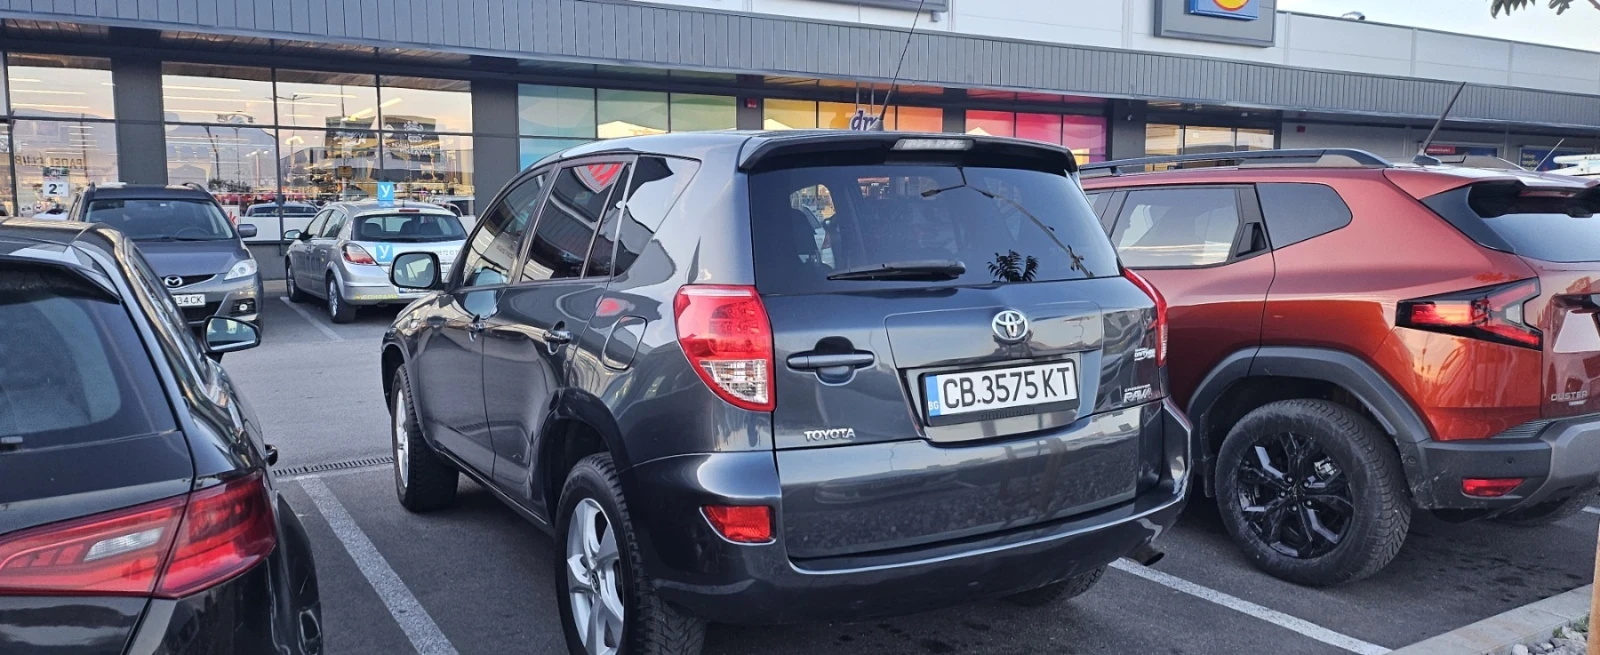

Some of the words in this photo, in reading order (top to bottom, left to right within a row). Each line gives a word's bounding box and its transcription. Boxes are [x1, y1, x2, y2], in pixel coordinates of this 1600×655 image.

[851, 110, 878, 131] dm
[174, 296, 189, 305] 34
[1550, 390, 1588, 402] DUSTER
[928, 400, 939, 411] BG
[803, 427, 856, 441] TOYOTA
